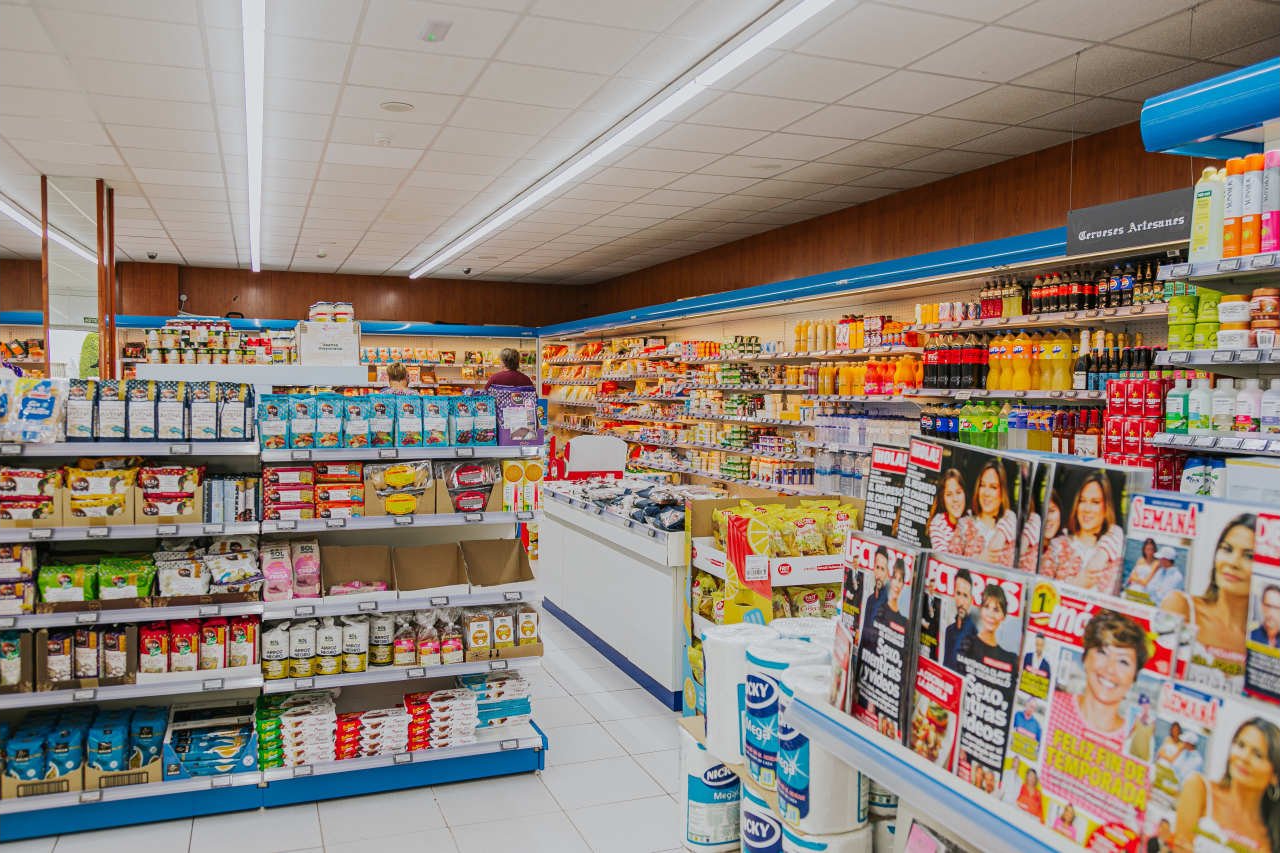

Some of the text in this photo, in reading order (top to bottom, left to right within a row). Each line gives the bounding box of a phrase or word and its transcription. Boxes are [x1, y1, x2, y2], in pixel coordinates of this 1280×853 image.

[1126, 215, 1185, 233] Artesanes
[1131, 495, 1198, 537] SEMANA
[877, 637, 903, 669] Sexo,
[965, 674, 1008, 711] Sexo,
[706, 766, 732, 781] NICK
[1053, 729, 1148, 786] FELIZ FIN DE
[1046, 748, 1147, 812] TEMPORADA
